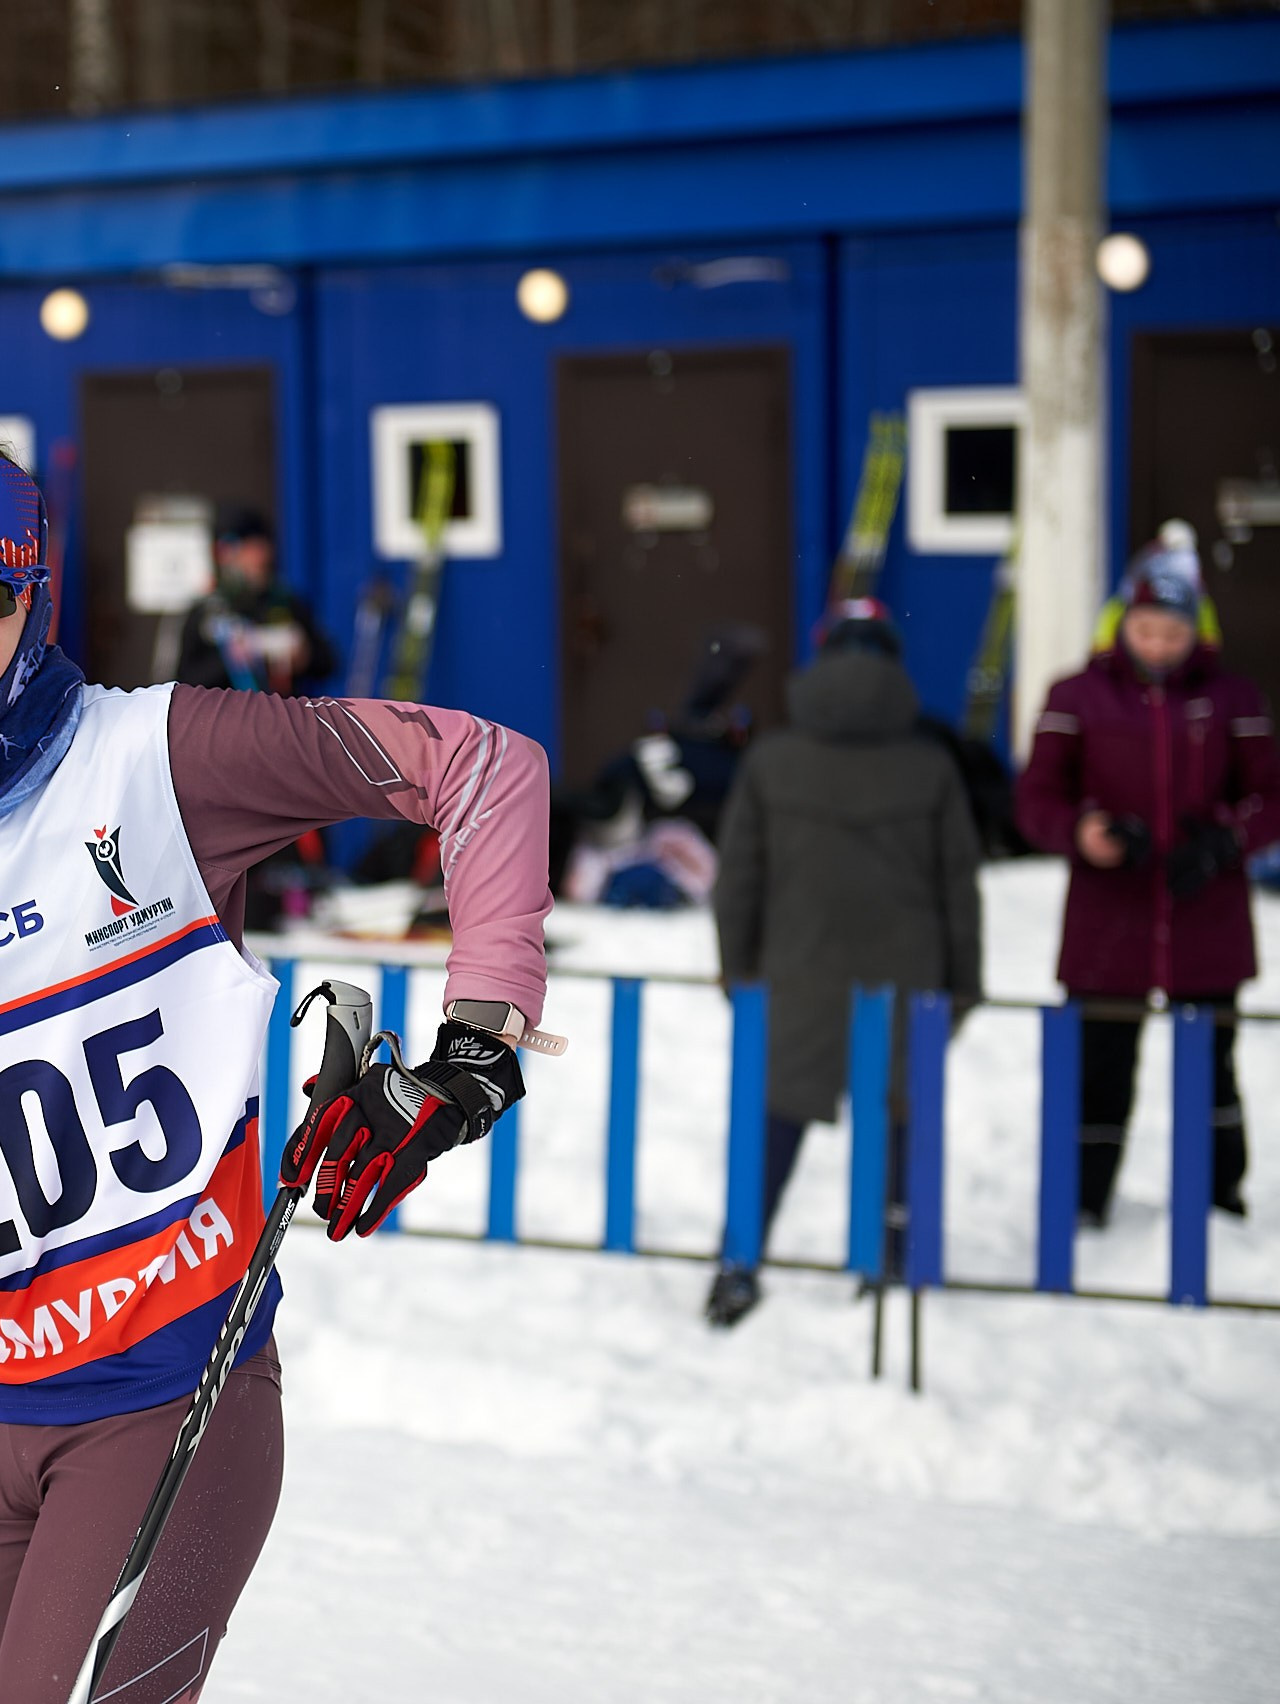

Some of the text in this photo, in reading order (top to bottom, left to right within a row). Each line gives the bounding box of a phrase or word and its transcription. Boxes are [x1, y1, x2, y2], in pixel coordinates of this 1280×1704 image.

[84, 896, 174, 947] МИНСПОРТ УДМУРТИИ
[448, 1036, 483, 1054] RAY
